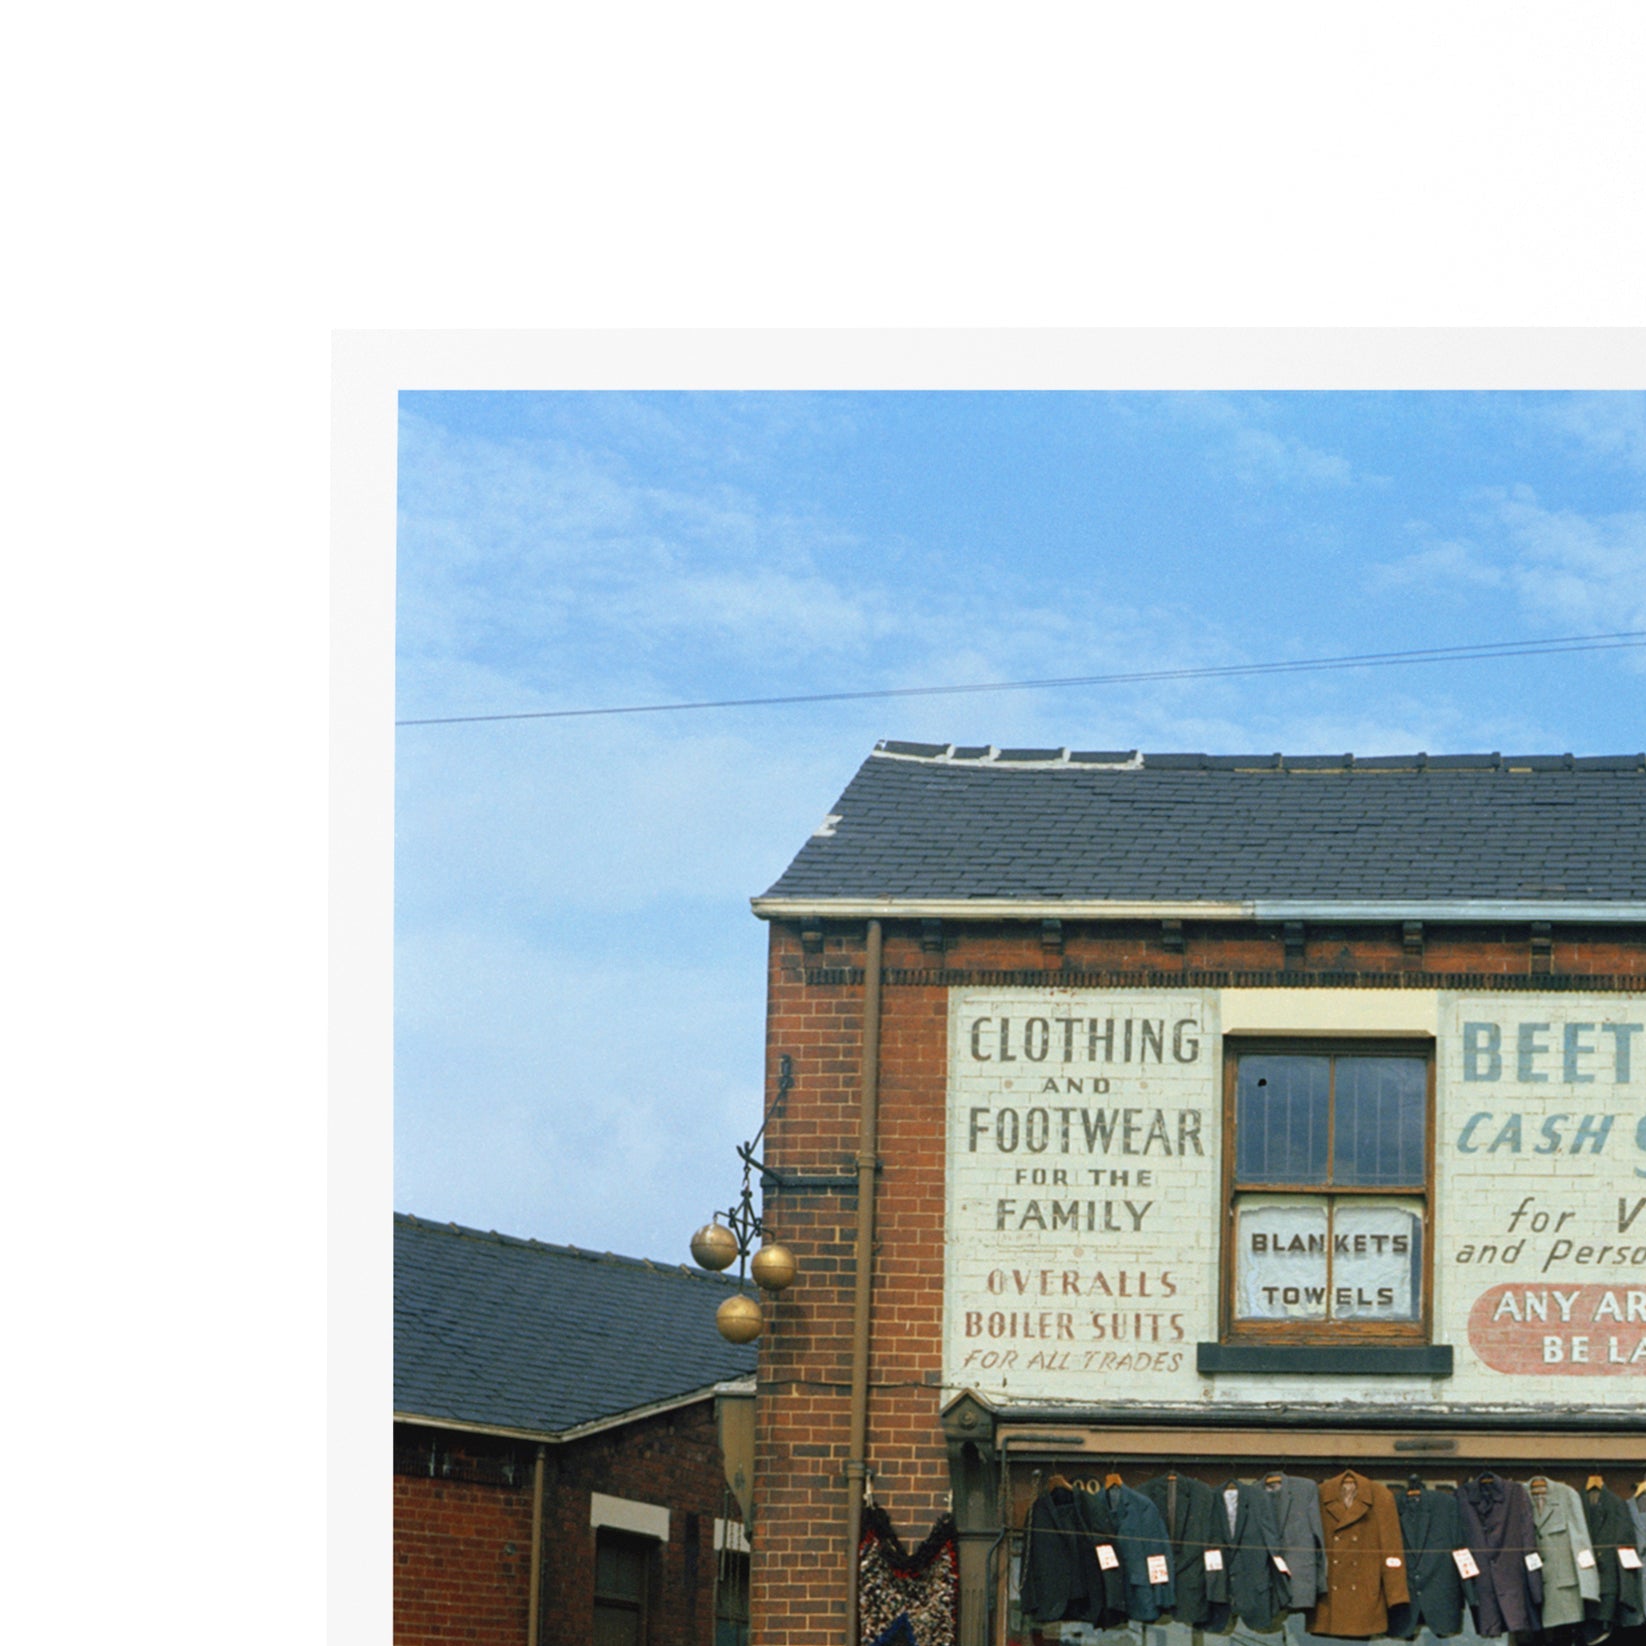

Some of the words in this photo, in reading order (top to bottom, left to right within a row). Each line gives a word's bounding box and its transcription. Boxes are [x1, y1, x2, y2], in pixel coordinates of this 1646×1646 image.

[970, 1016, 1199, 1063] CLOTHING
[1042, 1077, 1110, 1095] AND
[968, 1106, 1204, 1157] FOOTWEAR
[1457, 1111, 1615, 1154] CASH
[1015, 1168, 1068, 1187] FOR
[1089, 1169, 1151, 1187] THE
[996, 1199, 1153, 1232] FAMILY
[1508, 1197, 1576, 1233] for
[1252, 1233, 1409, 1254] BLANKETS
[1456, 1240, 1526, 1264] and
[987, 1269, 1177, 1298] OVERALLS
[1263, 1287, 1394, 1306] TOWELS
[1494, 1291, 1581, 1323] ANY
[965, 1311, 1074, 1340] BOILER
[1091, 1312, 1185, 1342] SUITS
[963, 1350, 1018, 1370] FOR
[1026, 1350, 1071, 1371] ALL
[1083, 1350, 1184, 1372] TRADES
[1542, 1336, 1590, 1365] BE
